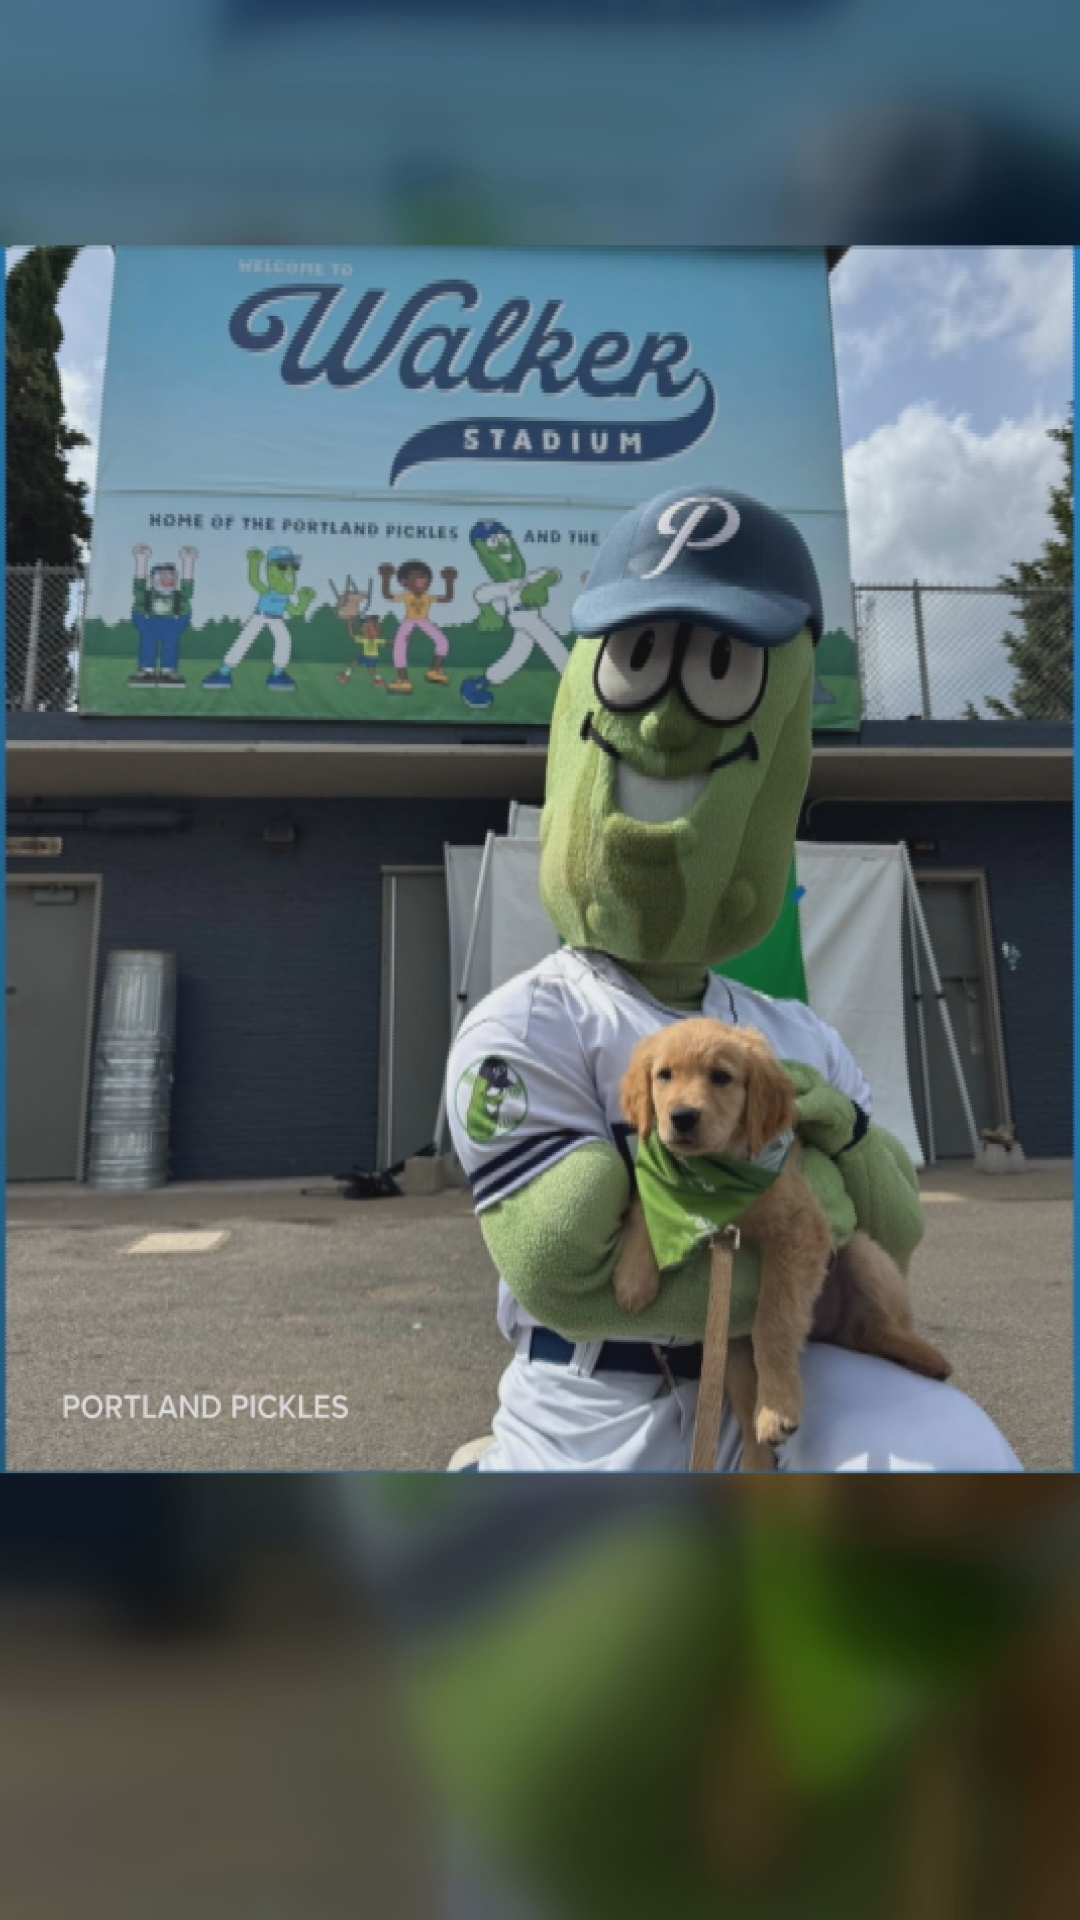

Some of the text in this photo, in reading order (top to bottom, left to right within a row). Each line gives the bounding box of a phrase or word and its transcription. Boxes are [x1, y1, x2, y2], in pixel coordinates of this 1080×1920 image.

[239, 259, 354, 277] WELCOME TO
[229, 279, 706, 398] Walker
[462, 427, 643, 455] STADIUM
[149, 513, 600, 547] HOME OF THE PORTLAND PICKLES AND THE
[640, 496, 741, 579] P
